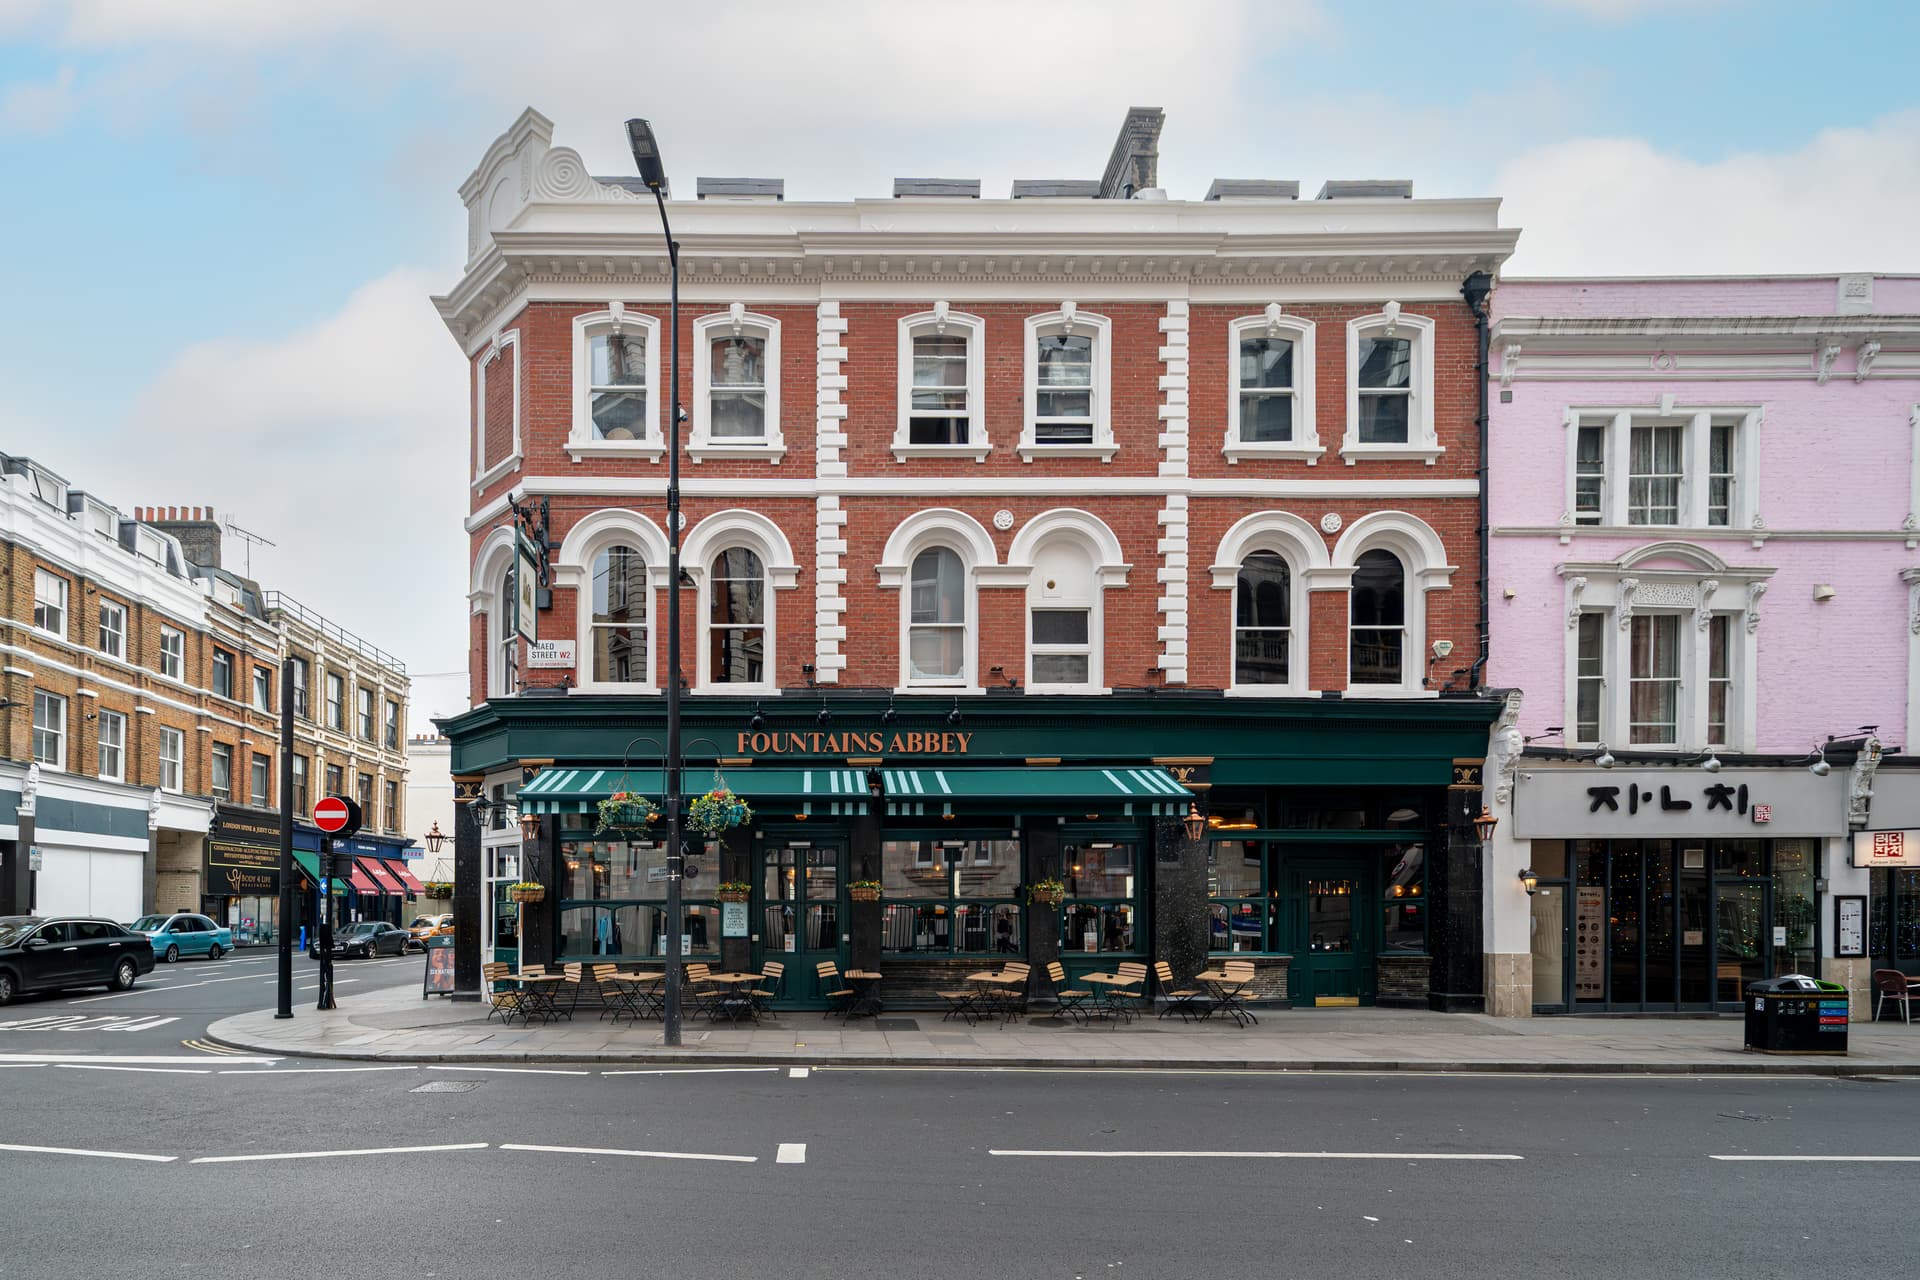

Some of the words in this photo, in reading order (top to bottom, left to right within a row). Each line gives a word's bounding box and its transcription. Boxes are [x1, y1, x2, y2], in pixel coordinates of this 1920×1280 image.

[531, 651, 557, 659] STREET
[559, 651, 571, 659] W2
[737, 731, 884, 754] FOUNTAINS
[888, 731, 973, 754] ABBEY
[223, 821, 241, 830] LONDON
[241, 874, 257, 883] BODY
[262, 876, 272, 884] LIFE
